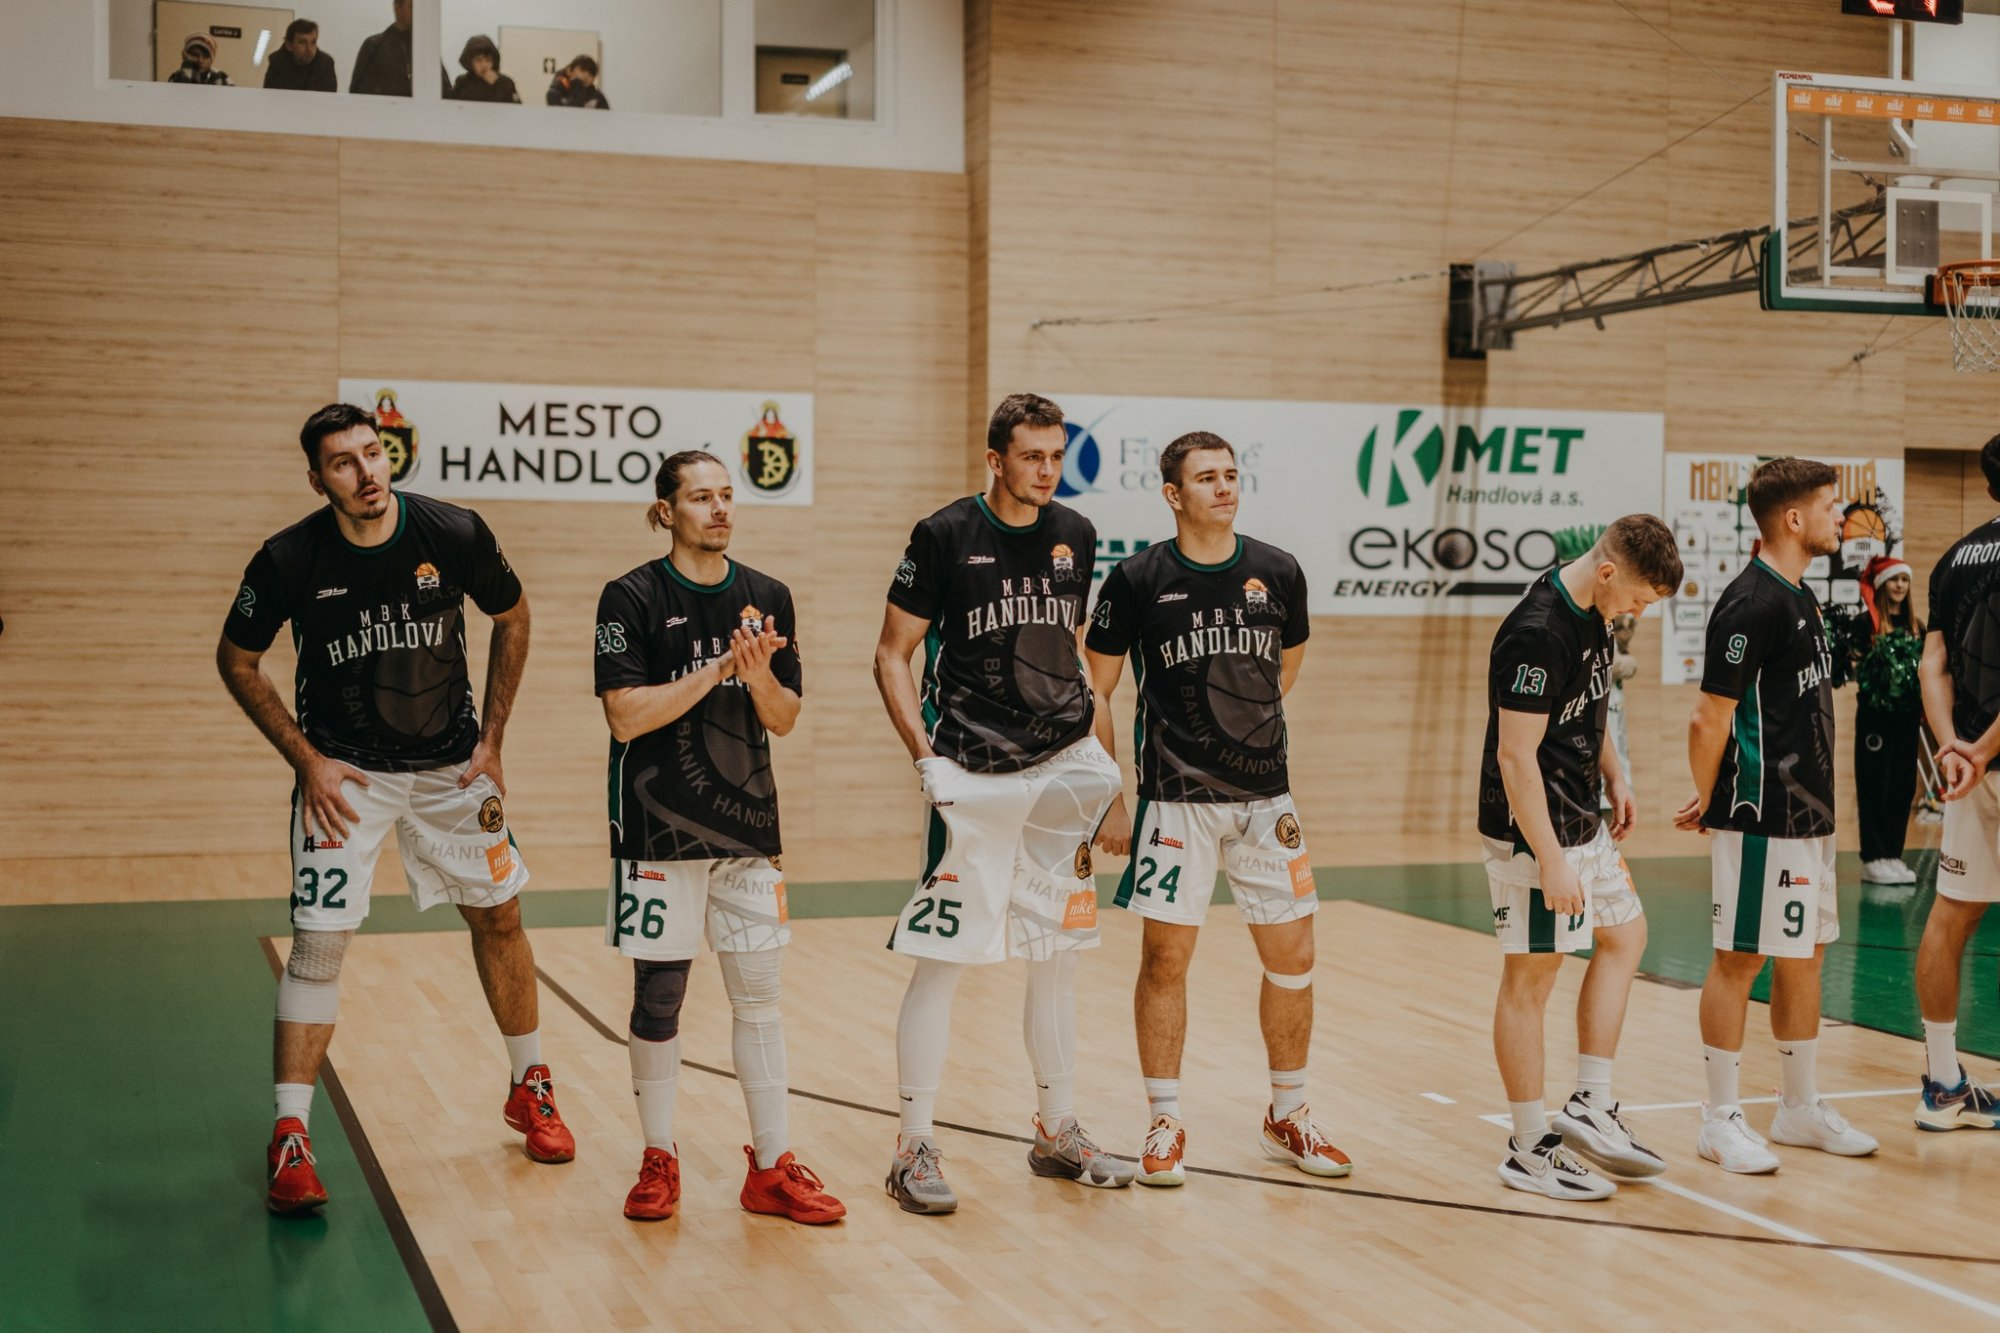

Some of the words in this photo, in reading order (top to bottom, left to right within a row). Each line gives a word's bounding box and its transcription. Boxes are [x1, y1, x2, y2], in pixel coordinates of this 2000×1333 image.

[499, 402, 662, 438] MESTO
[1445, 485, 1544, 506] Handlová
[1549, 488, 1584, 506] a.s.
[1333, 579, 1450, 598] ENERGY
[326, 617, 444, 667] HANDLOVÁ
[1160, 626, 1274, 669] HANDLOVÁ
[1725, 632, 1748, 665] 9
[1511, 663, 1548, 697] 13
[298, 867, 349, 909] 32
[1135, 855, 1182, 903] 24
[619, 892, 668, 940] 26
[907, 896, 963, 938] 25
[1782, 900, 1805, 938] 9
